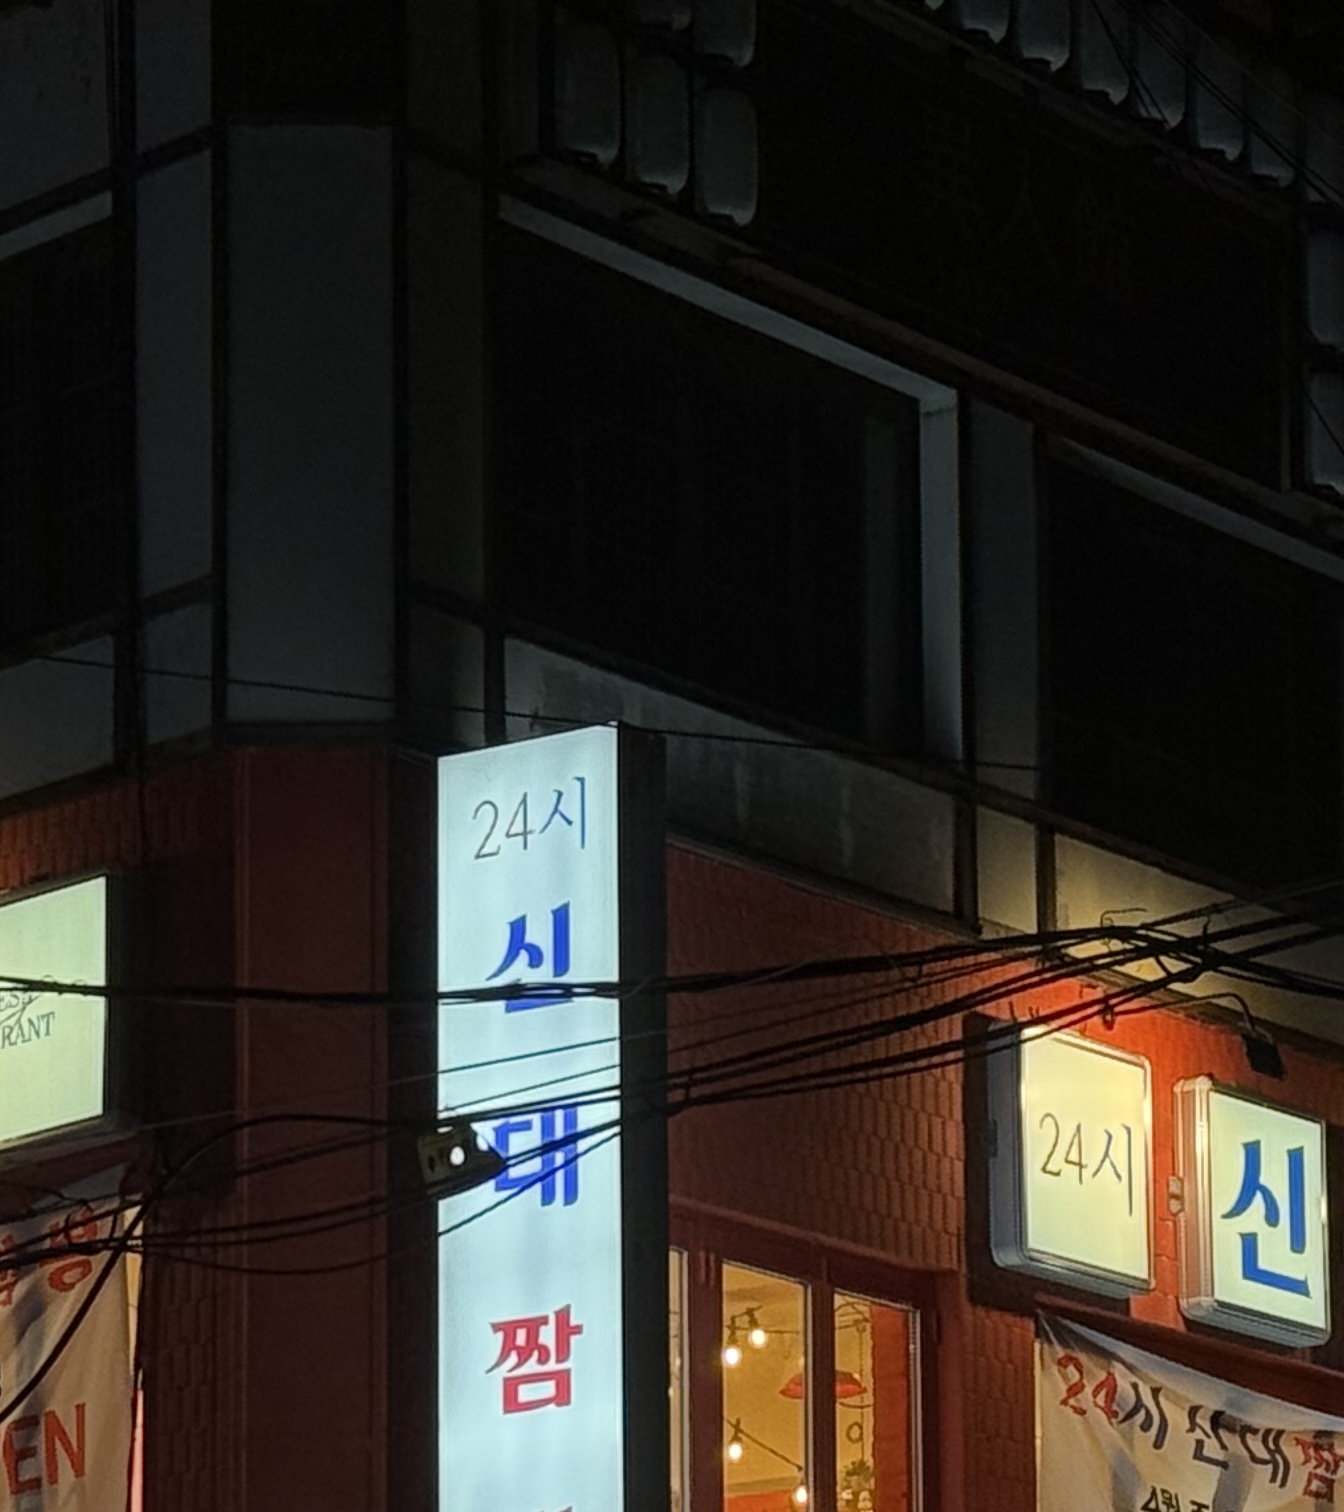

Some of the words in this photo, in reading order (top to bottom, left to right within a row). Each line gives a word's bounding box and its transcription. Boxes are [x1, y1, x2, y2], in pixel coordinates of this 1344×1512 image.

[474, 776, 588, 862] 24시
[1039, 1111, 1134, 1218] 24시
[1057, 1353, 1168, 1450] 24시
